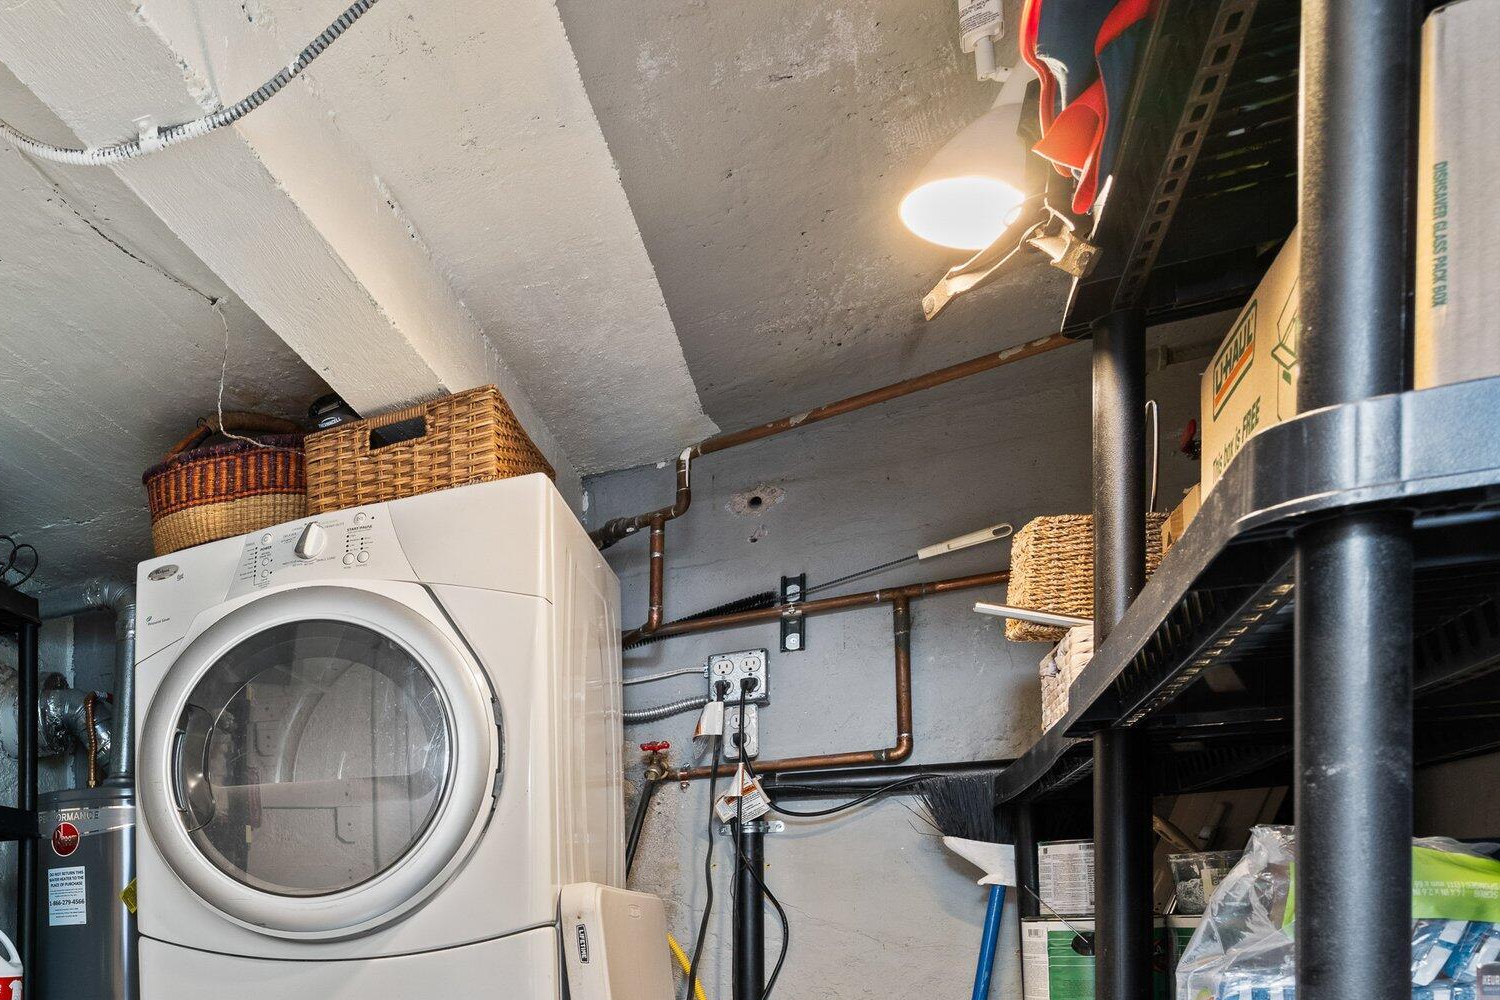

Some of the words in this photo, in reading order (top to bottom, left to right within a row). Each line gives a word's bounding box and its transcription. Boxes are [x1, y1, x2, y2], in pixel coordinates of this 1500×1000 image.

[1433, 161, 1448, 220] DISHSAVER
[1433, 220, 1447, 254] GLASS
[1432, 255, 1447, 284] PACK
[1432, 285, 1447, 308] BOX
[1215, 314, 1254, 396] U-HAUL
[1242, 395, 1261, 443] FREE
